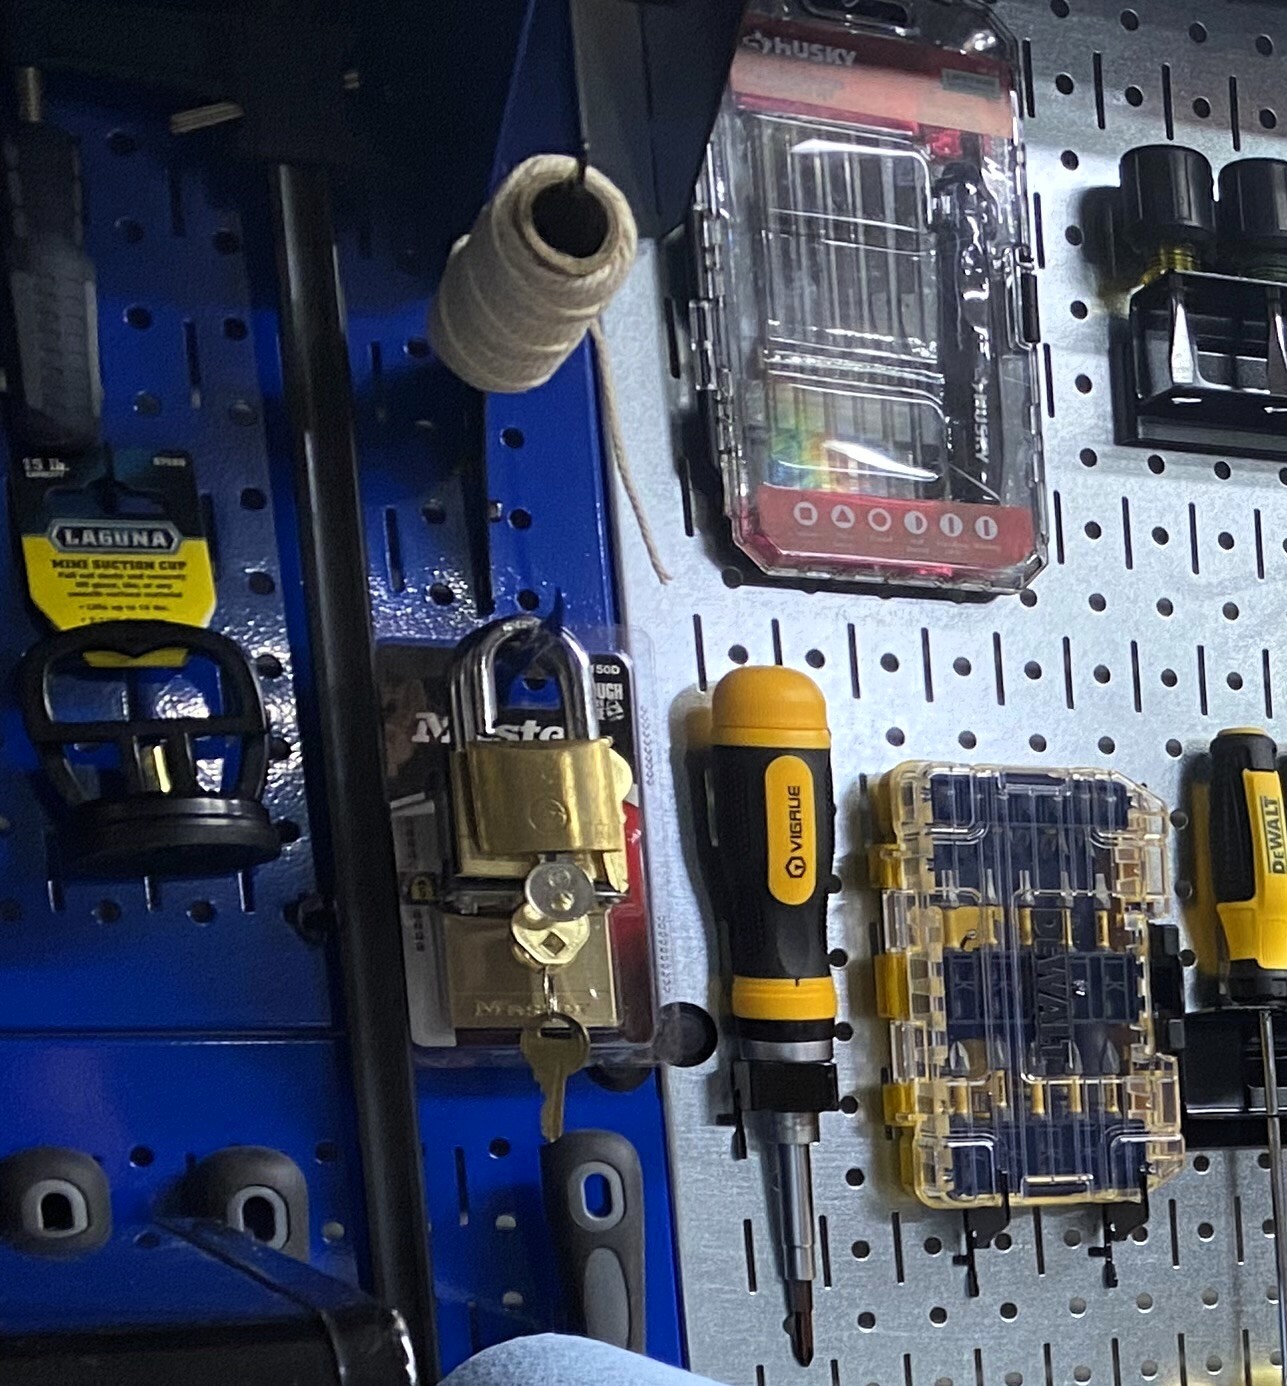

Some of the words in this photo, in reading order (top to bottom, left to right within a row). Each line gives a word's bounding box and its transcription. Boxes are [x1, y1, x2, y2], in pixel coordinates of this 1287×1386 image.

[63, 528, 169, 548] LAGUNA
[52, 559, 88, 570] MINI
[92, 560, 155, 571] SUCTION
[159, 561, 187, 571] CUP
[411, 712, 566, 743] Mste
[789, 785, 803, 852] VIGRUE
